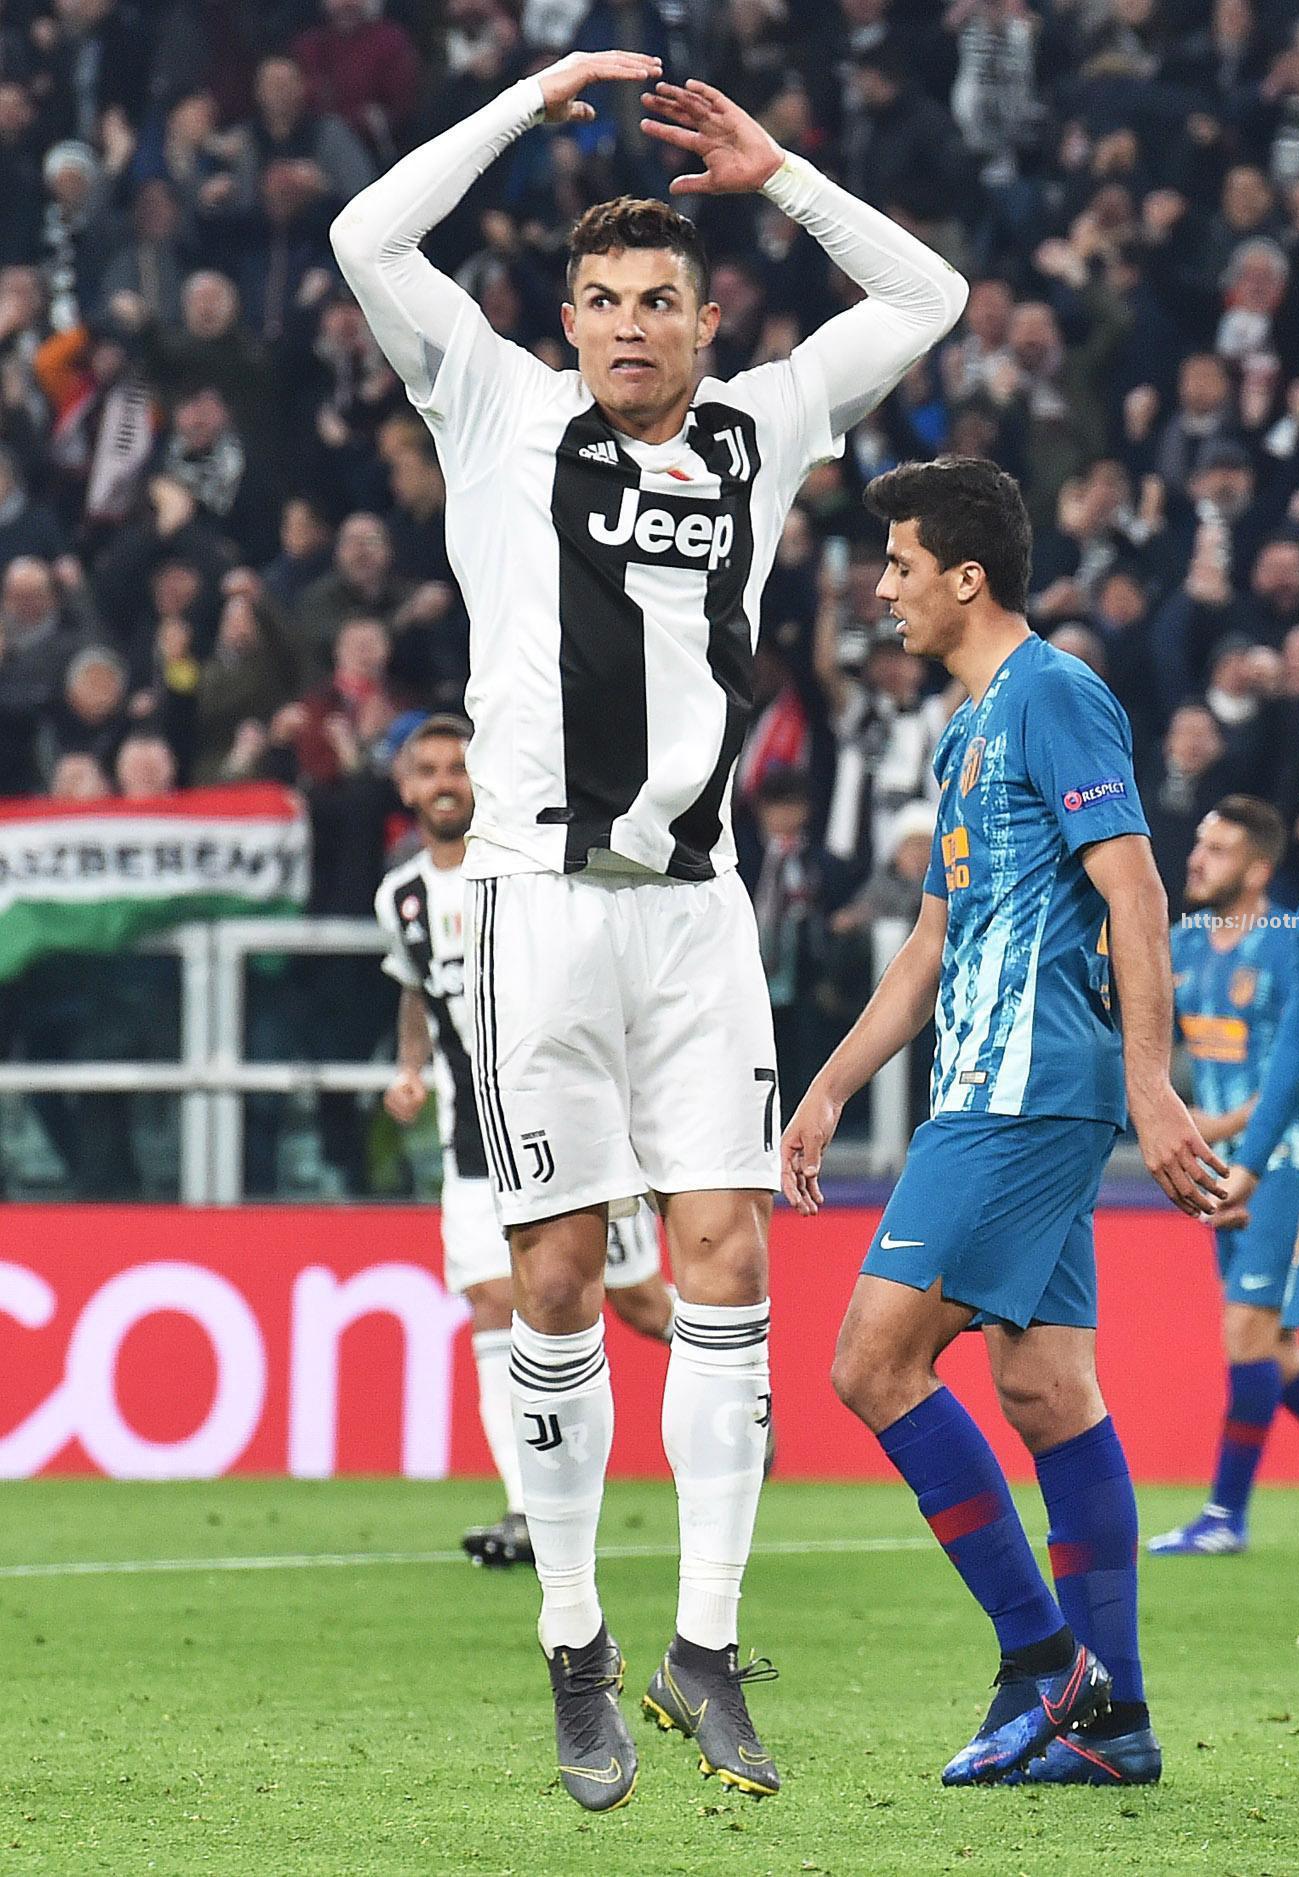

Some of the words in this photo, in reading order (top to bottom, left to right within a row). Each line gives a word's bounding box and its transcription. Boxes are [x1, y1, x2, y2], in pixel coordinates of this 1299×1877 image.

[588, 487, 734, 570] Jeep
[1081, 782, 1124, 802] RESPECT
[753, 1067, 776, 1153] 7
